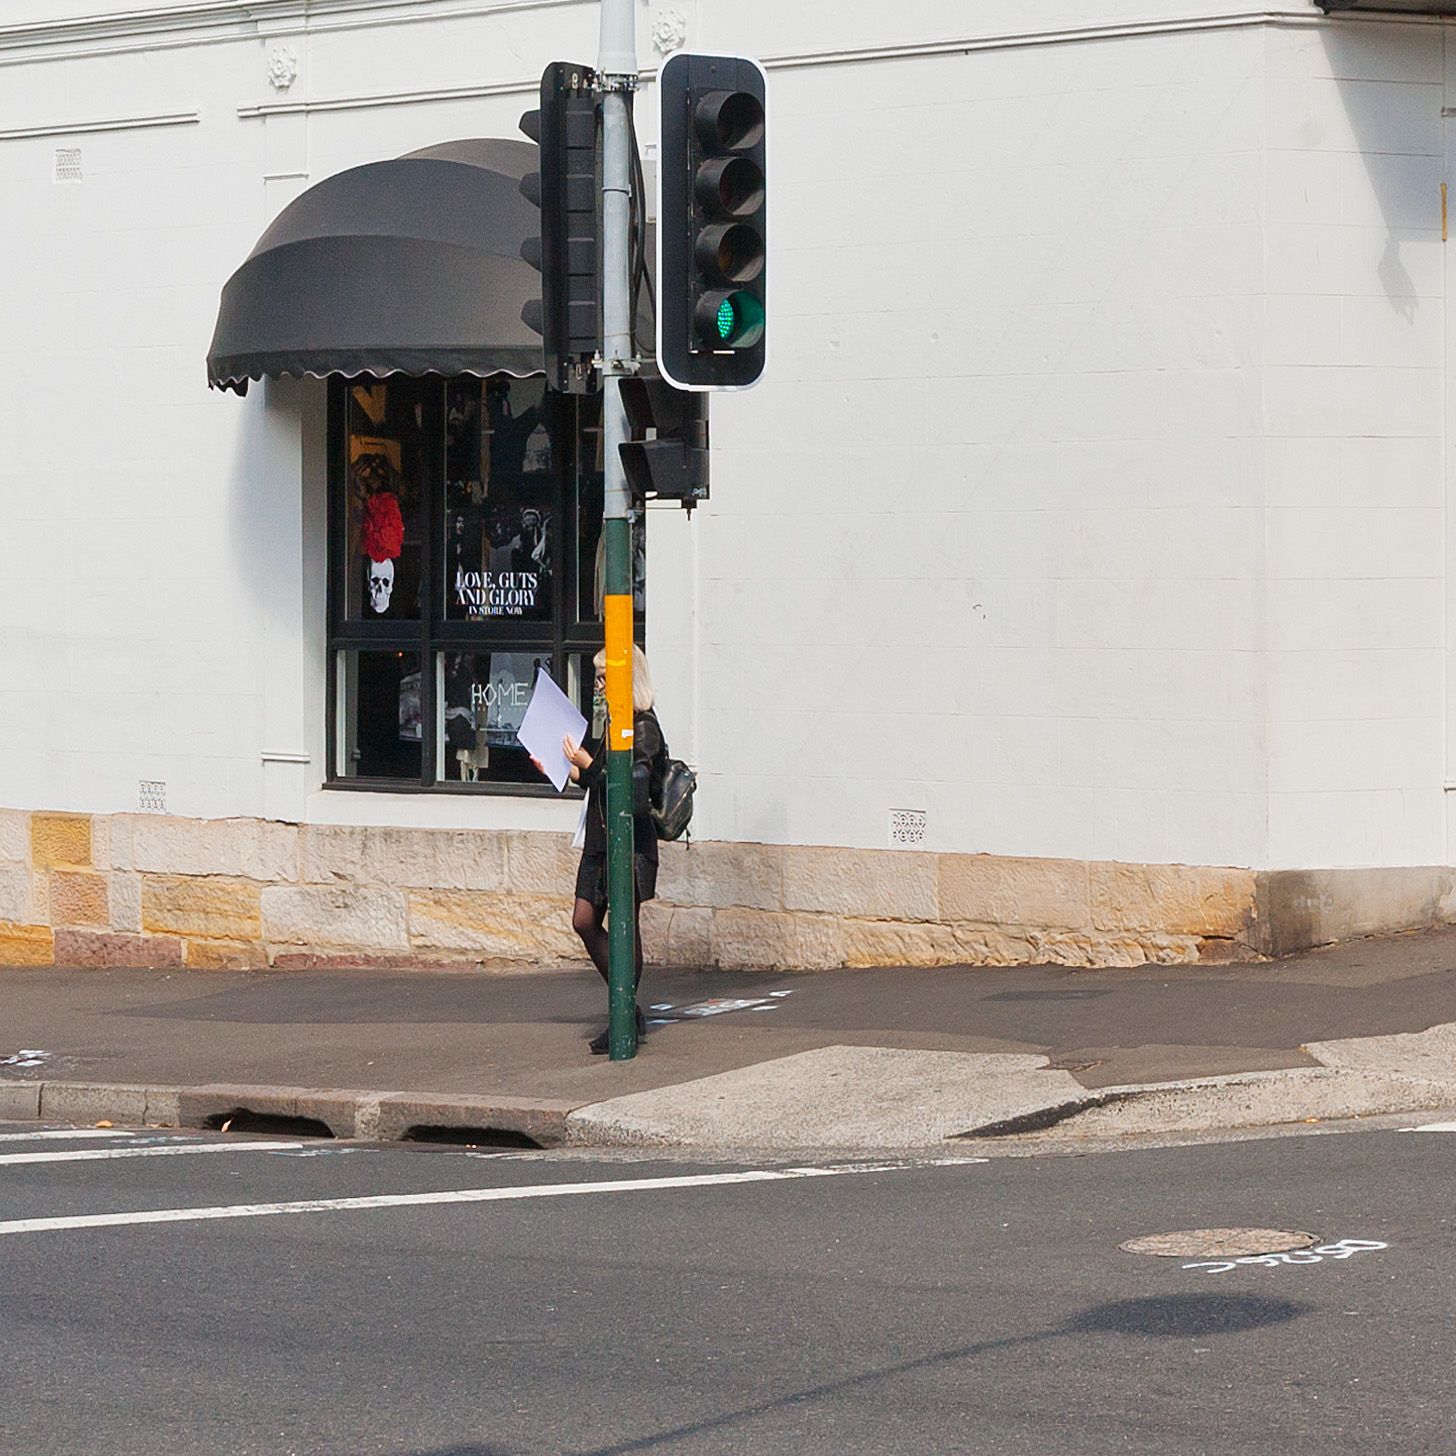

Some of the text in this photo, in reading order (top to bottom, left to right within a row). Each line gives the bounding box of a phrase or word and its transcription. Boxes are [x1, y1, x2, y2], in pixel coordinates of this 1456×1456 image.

[456, 571, 538, 590] LOVE, GUTS
[456, 589, 536, 606] AND GLORY
[469, 606, 523, 615] IN STORE NOW
[471, 683, 528, 706] HOME
